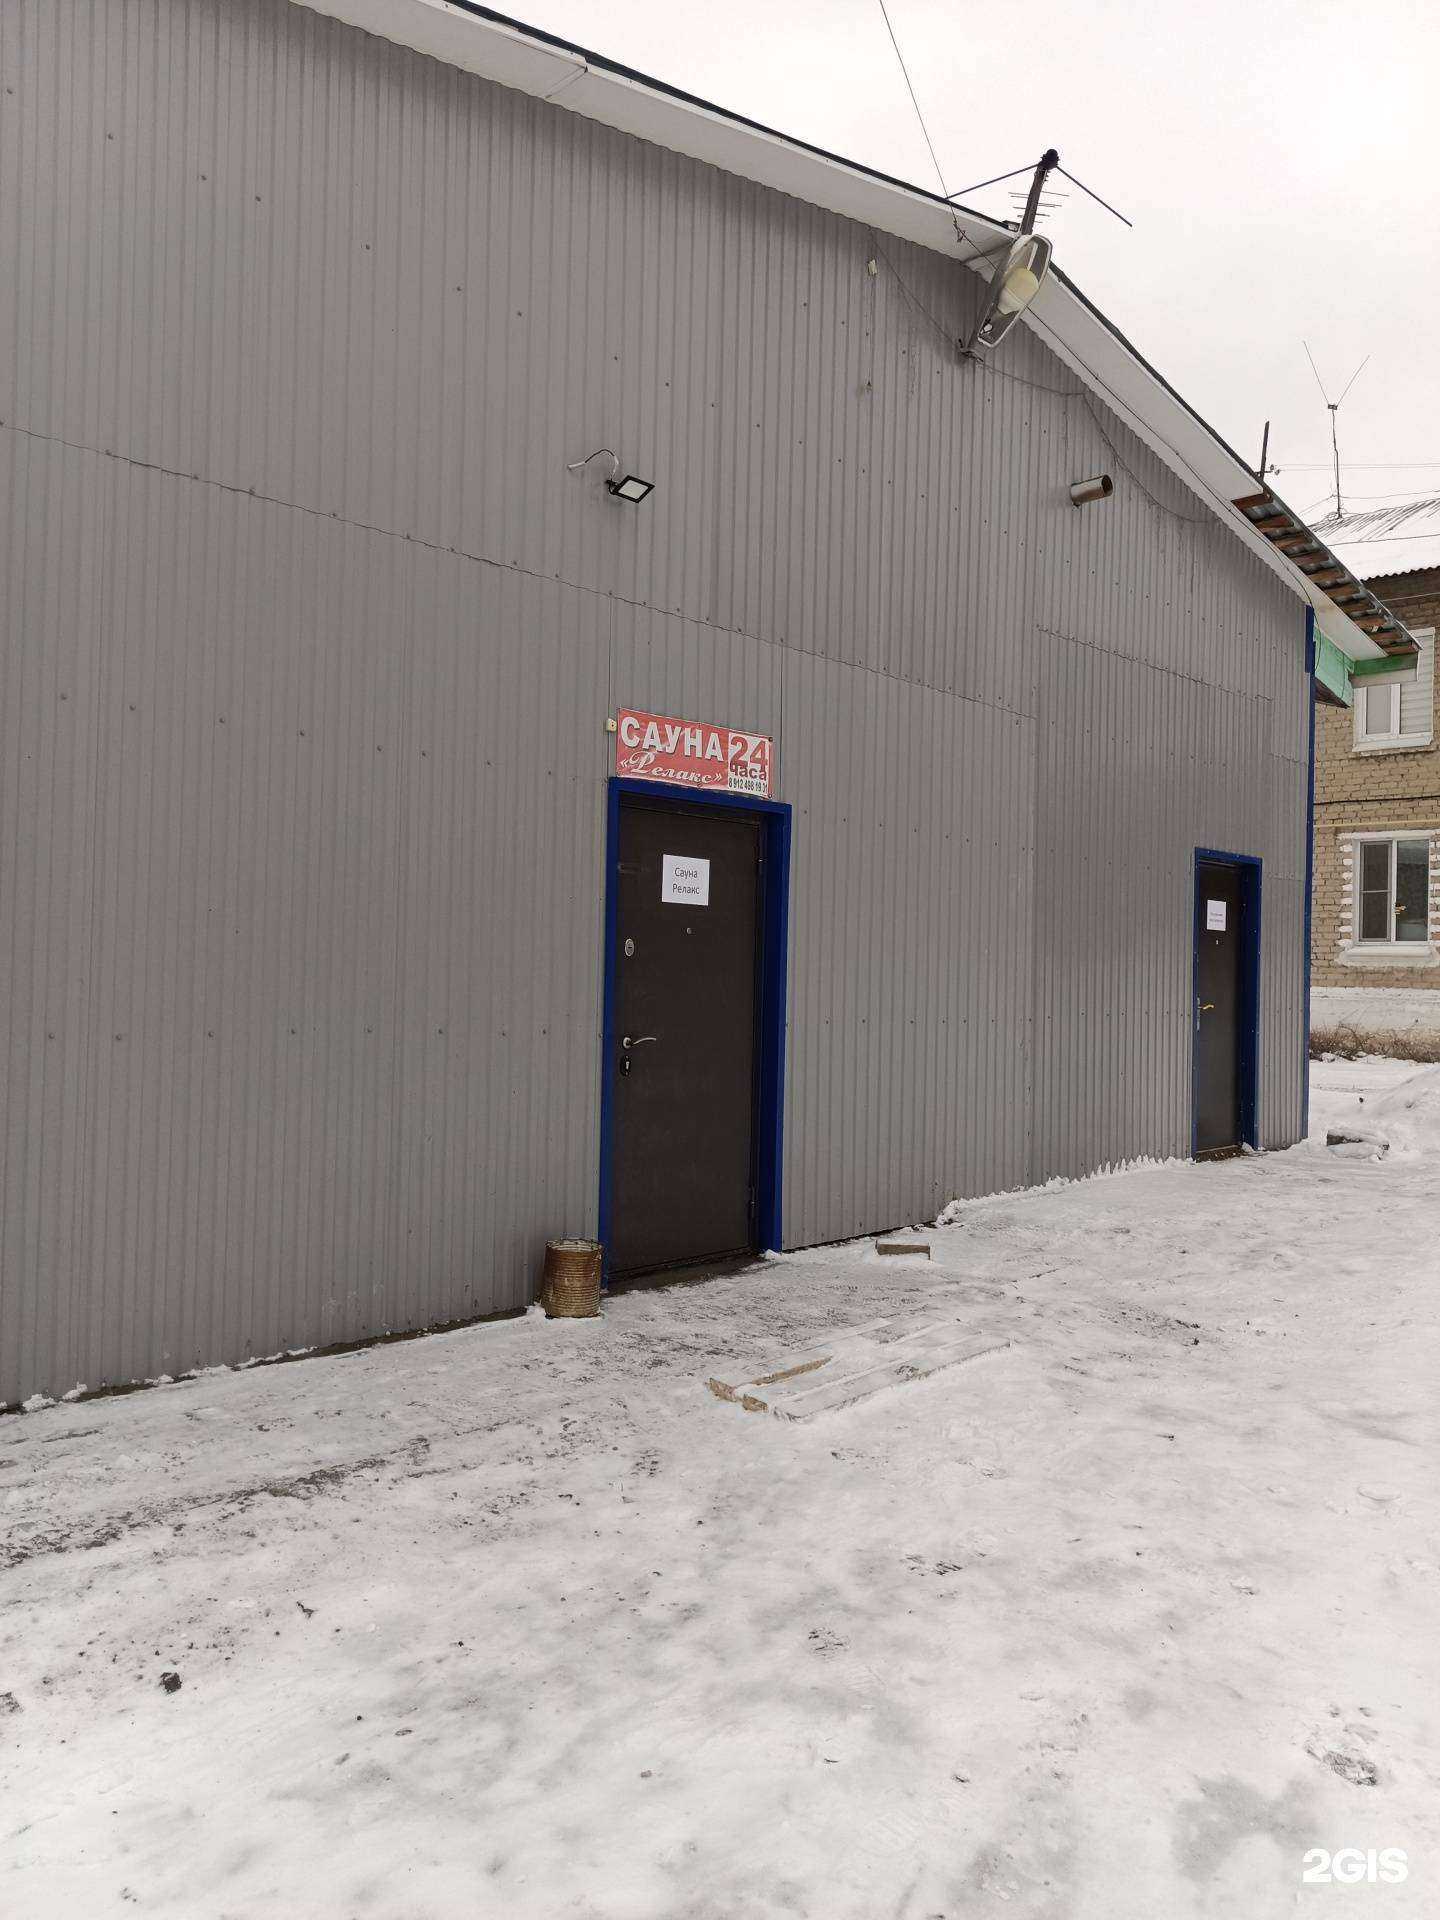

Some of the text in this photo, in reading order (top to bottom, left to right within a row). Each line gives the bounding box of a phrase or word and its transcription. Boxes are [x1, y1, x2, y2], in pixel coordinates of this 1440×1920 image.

[620, 716, 724, 762] САУНА
[730, 736, 768, 772] 24
[728, 777, 733, 788] 8
[674, 867, 698, 880] Сауна
[672, 883, 700, 895] Релакс
